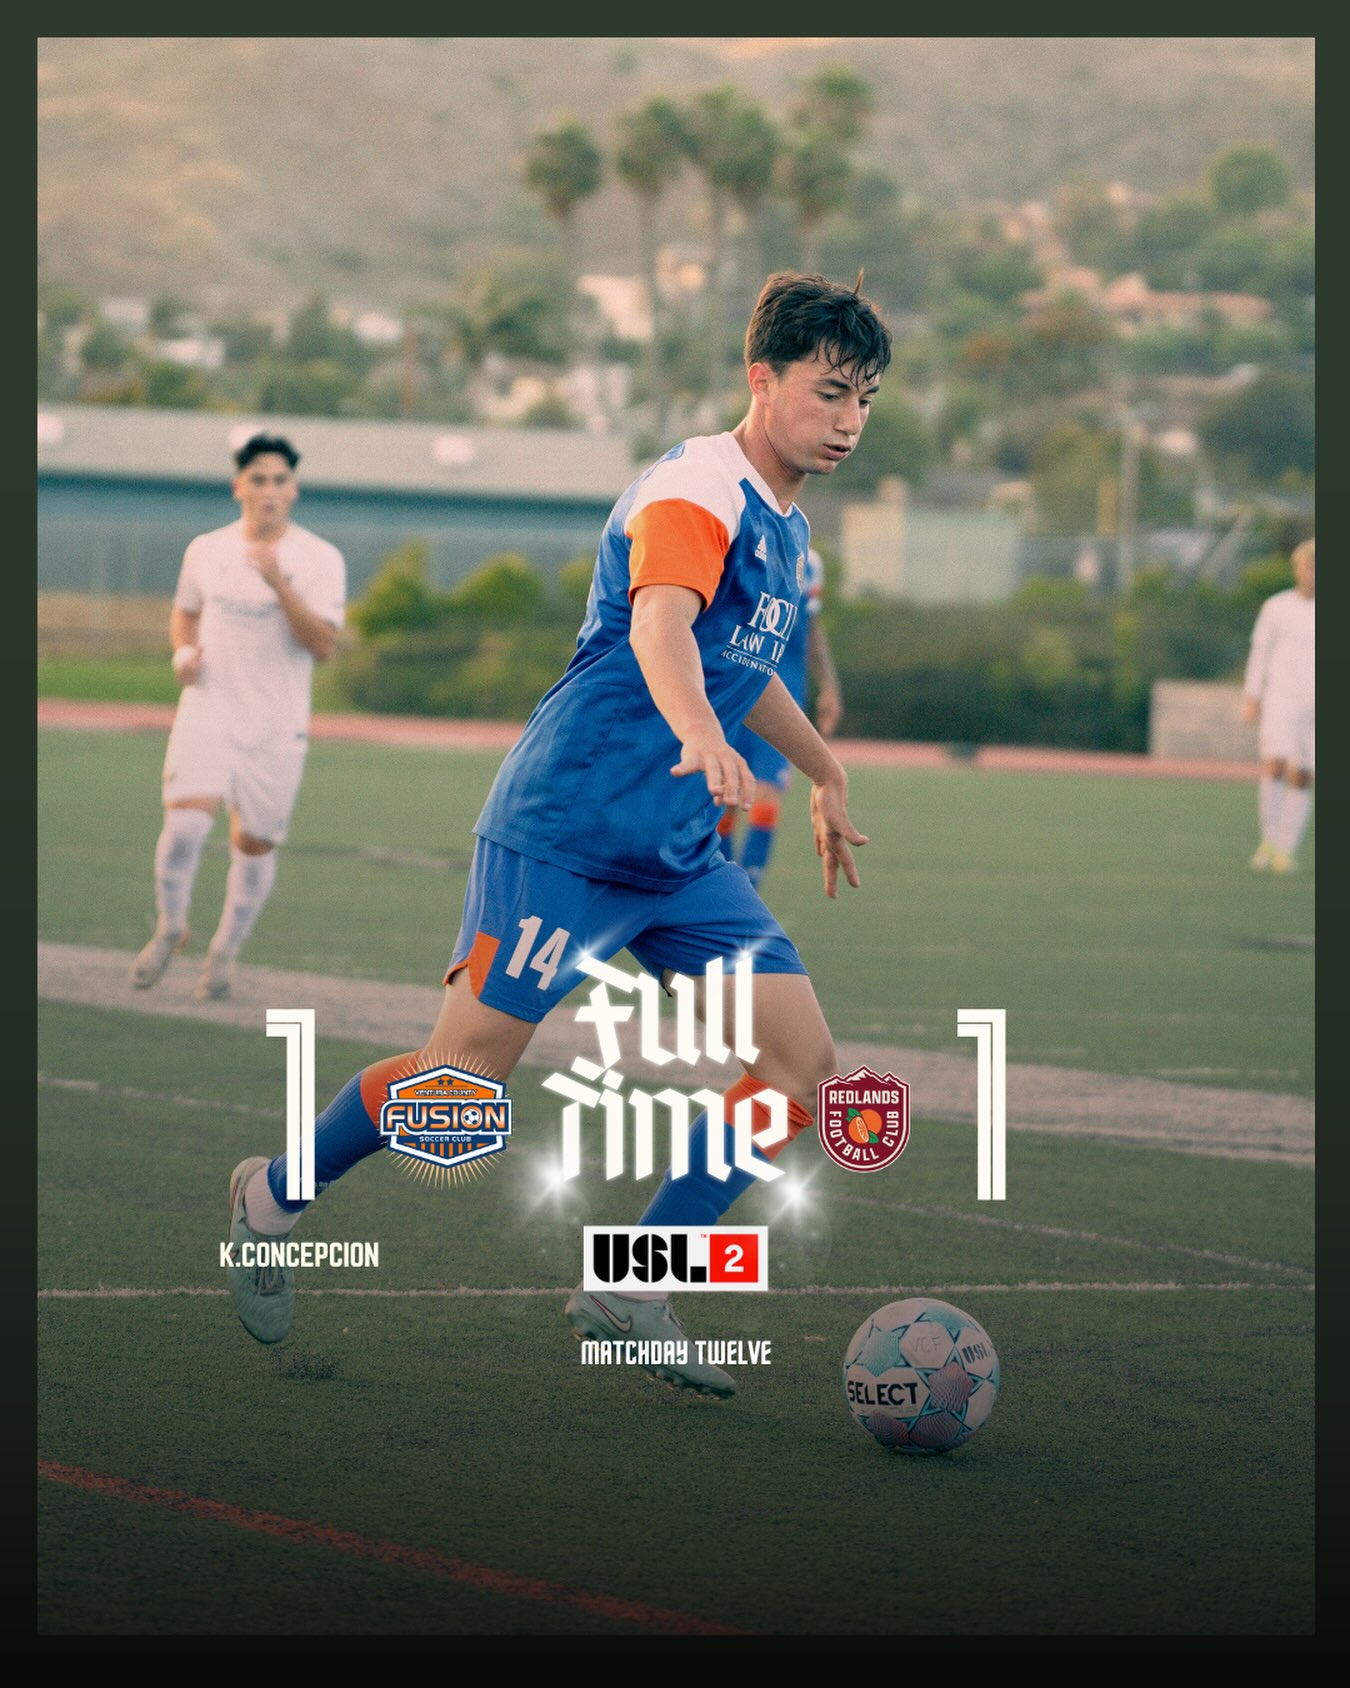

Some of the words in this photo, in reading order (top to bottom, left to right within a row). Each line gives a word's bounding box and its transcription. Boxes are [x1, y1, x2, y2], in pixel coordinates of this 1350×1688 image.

[729, 624, 765, 655] LAW
[505, 915, 570, 991] 14
[848, 1380, 918, 1406] SELECT
